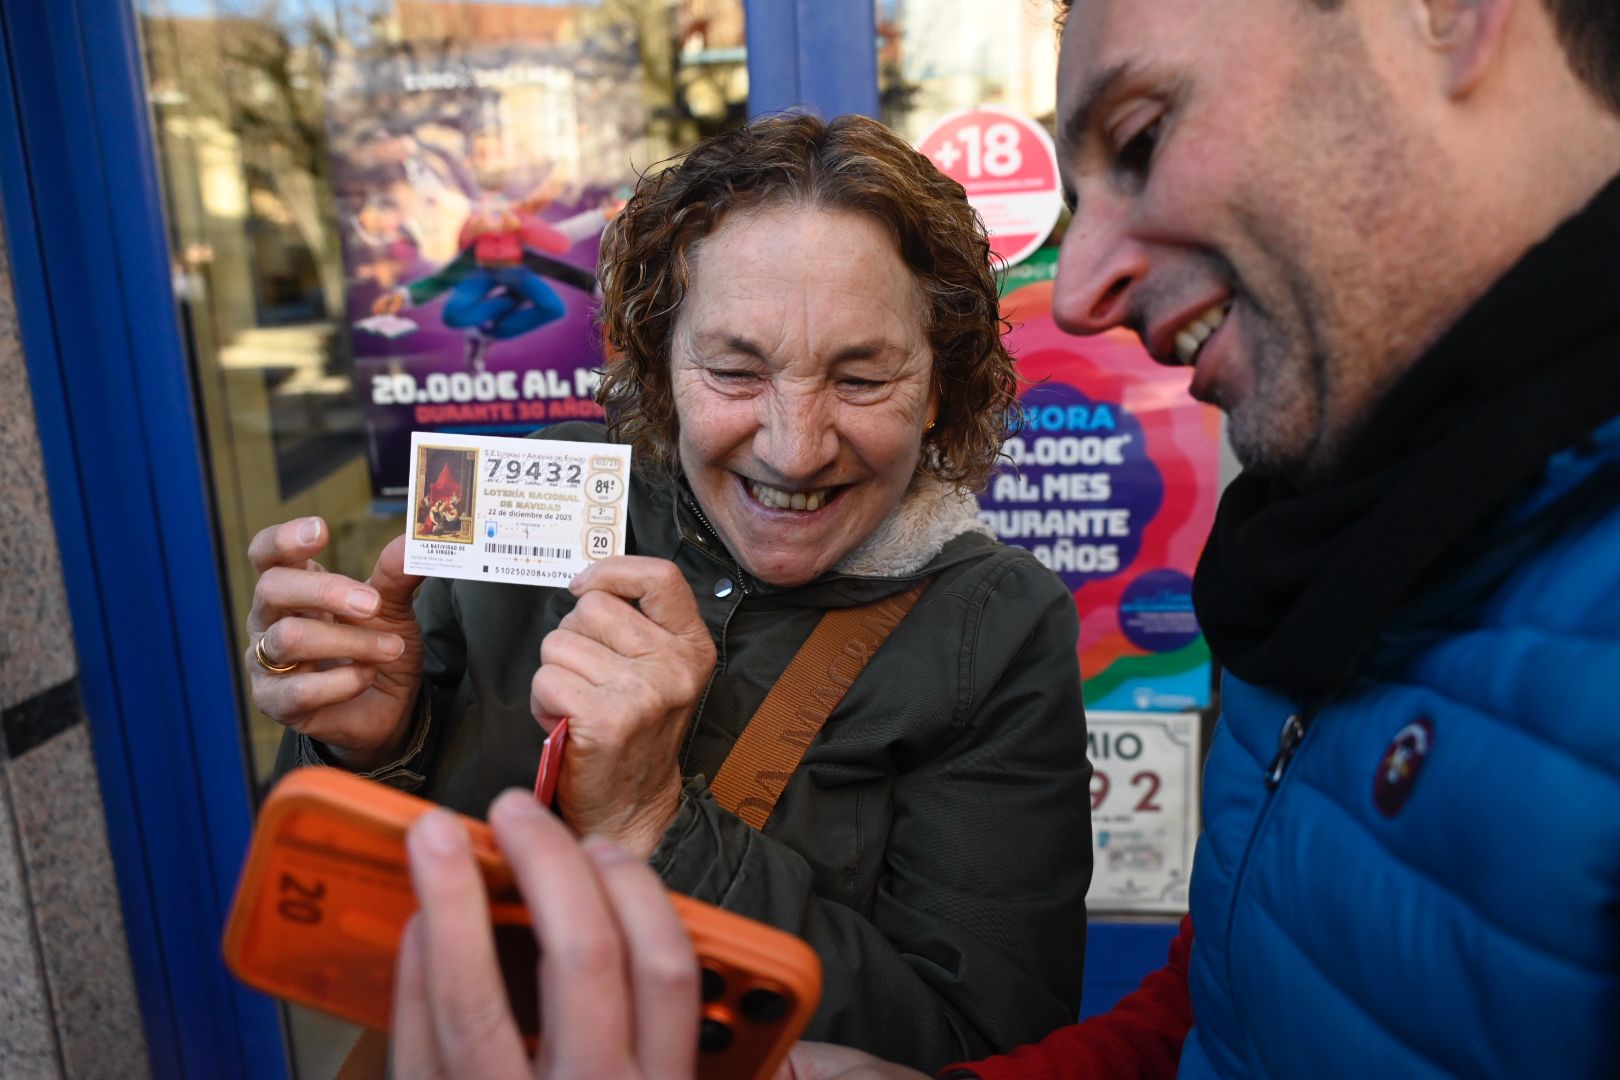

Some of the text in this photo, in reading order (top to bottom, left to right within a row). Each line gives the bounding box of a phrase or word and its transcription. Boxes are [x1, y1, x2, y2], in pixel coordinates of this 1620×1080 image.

[934, 121, 1024, 178] +18
[371, 371, 519, 405] 20.000€
[522, 369, 571, 399] AL
[414, 401, 514, 424] DURANTE
[488, 458, 582, 484] 79432
[483, 488, 580, 502] LOTERÍA NACIONAL
[993, 473, 1111, 502] AL MES
[500, 500, 562, 511] DE NAVIDAD
[508, 510, 543, 519] diciembre
[593, 536, 608, 548] 20
